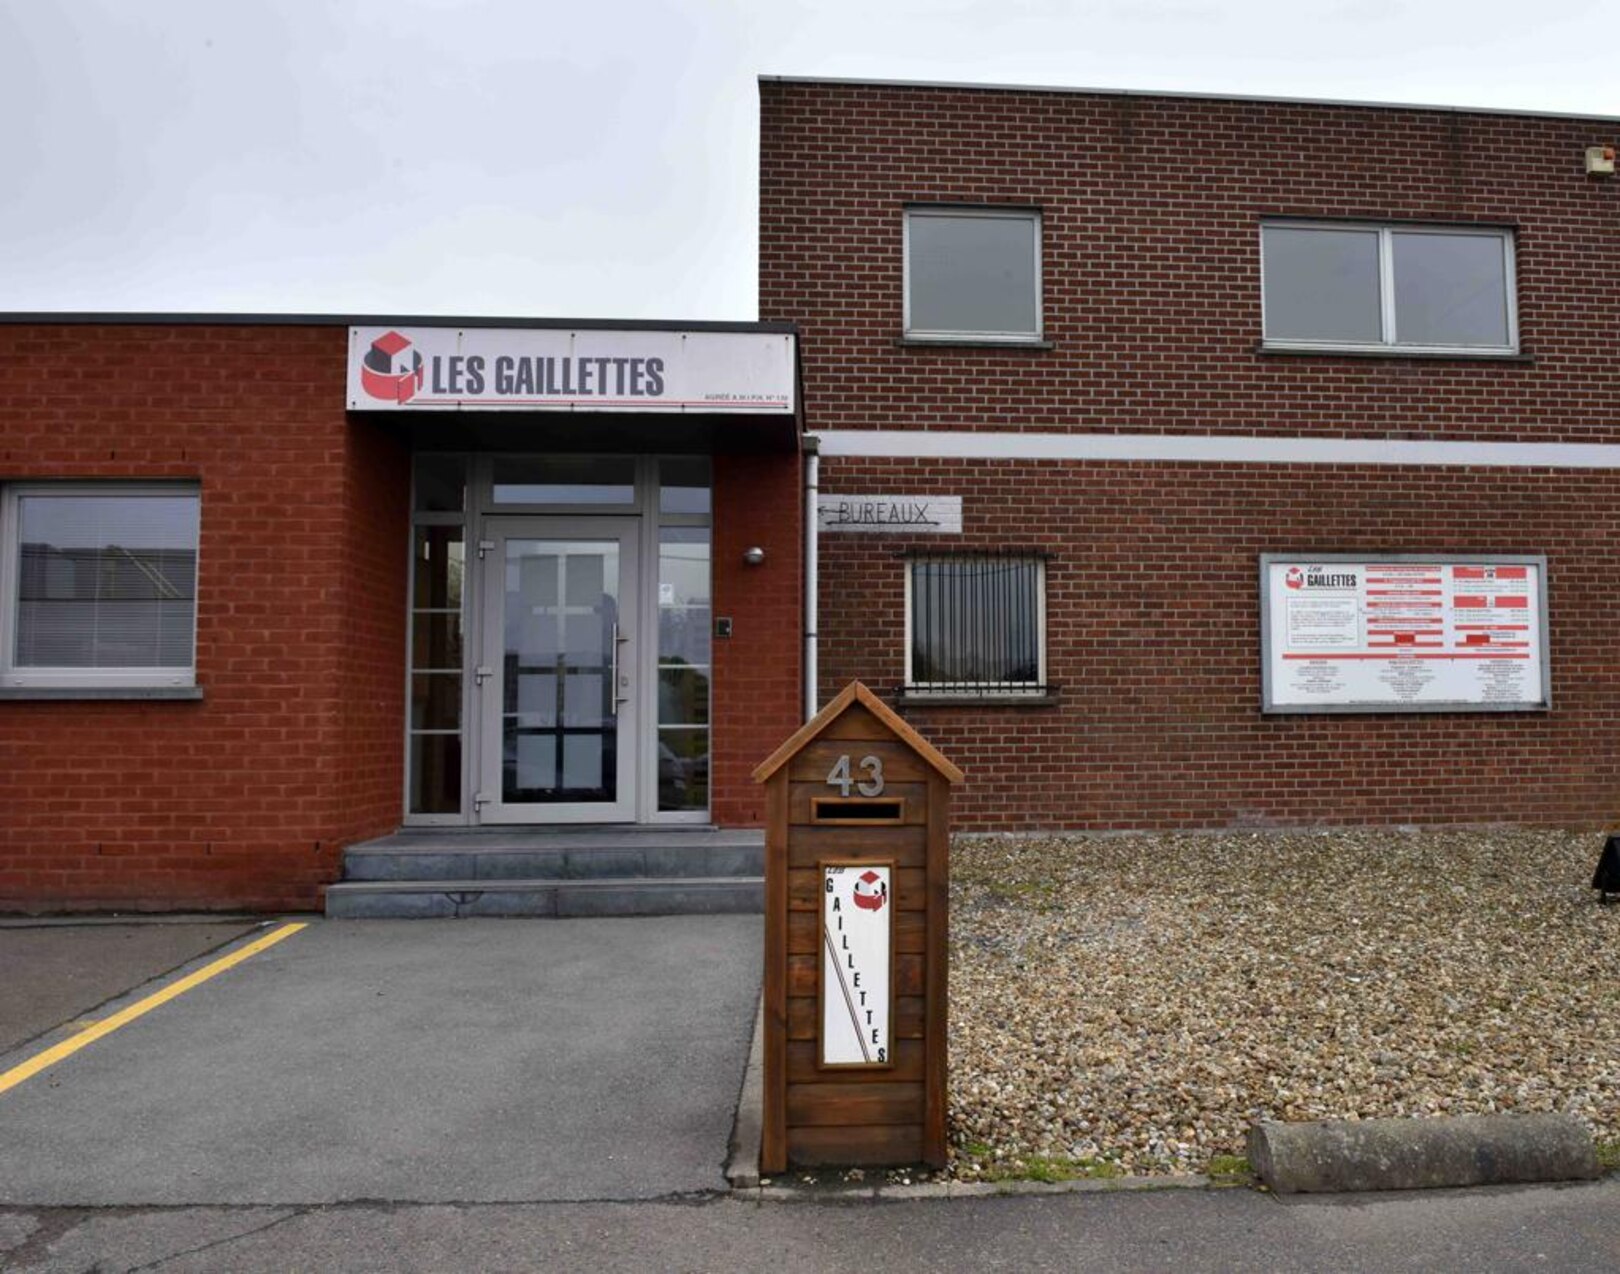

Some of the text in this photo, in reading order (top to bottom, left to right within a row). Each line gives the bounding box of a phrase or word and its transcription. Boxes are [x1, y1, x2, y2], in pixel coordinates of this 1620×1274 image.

[431, 355, 665, 396] LES GAILLETTES
[839, 501, 928, 522] BUREAUX
[1307, 574, 1356, 586] GAILLETTES
[826, 755, 884, 797] 43
